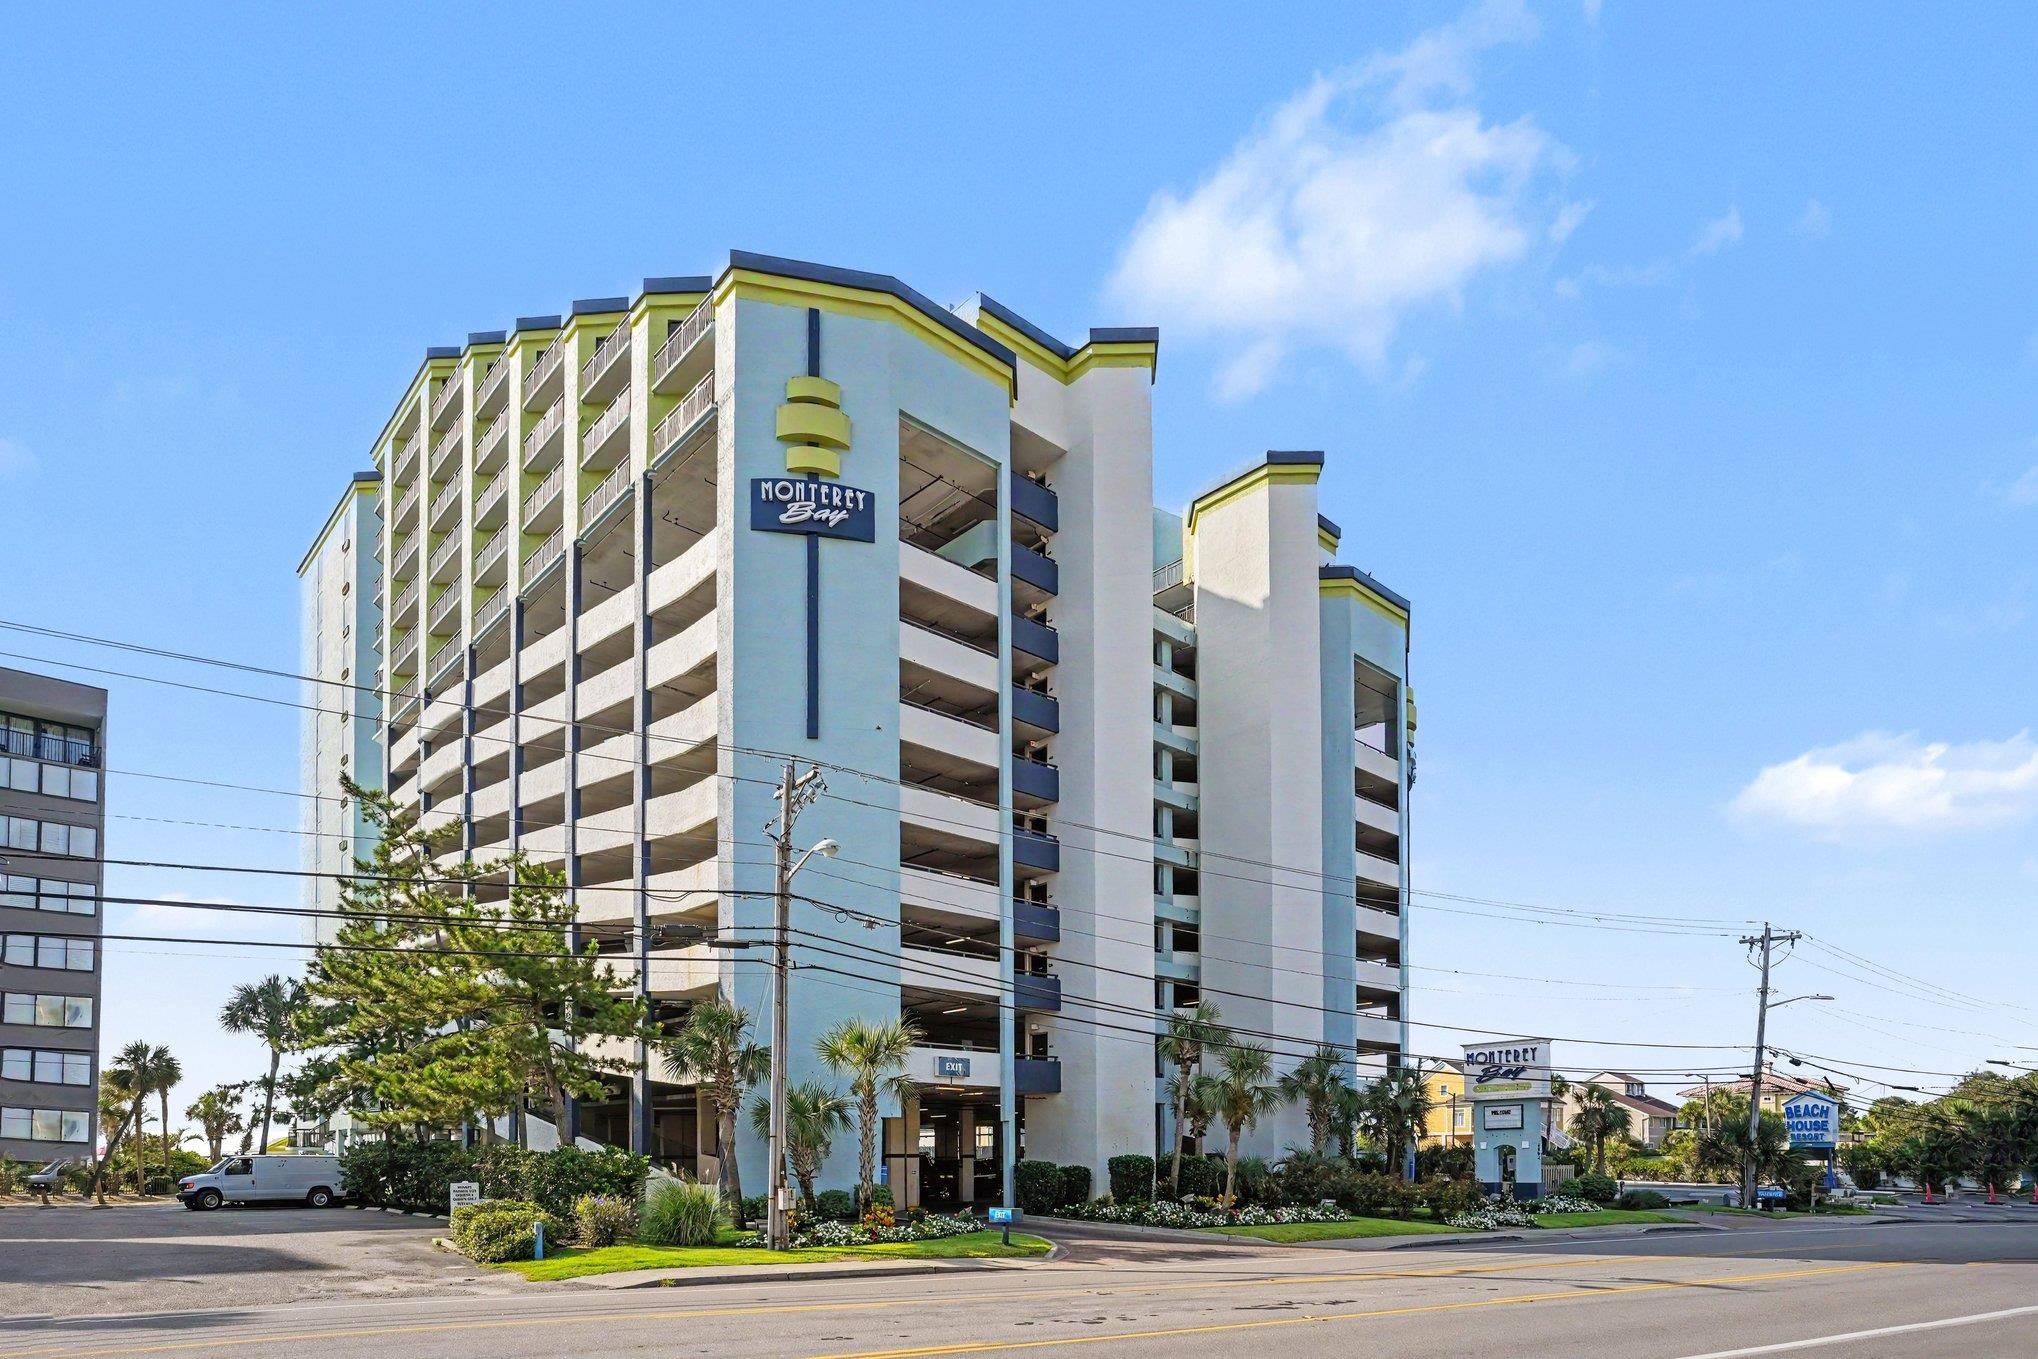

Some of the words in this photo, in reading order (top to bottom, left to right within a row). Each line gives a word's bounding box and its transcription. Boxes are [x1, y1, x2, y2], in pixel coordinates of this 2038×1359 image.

[761, 481, 866, 511] MONTEREY
[778, 501, 849, 528] Bay
[1466, 1047, 1537, 1066] MONTEREY
[945, 1062, 963, 1072] EXIT
[1476, 1064, 1527, 1083] Bay
[1785, 1104, 1830, 1119] BEACH
[1786, 1120, 1829, 1132] HOUSE
[1790, 1132, 1825, 1141] RESORT
